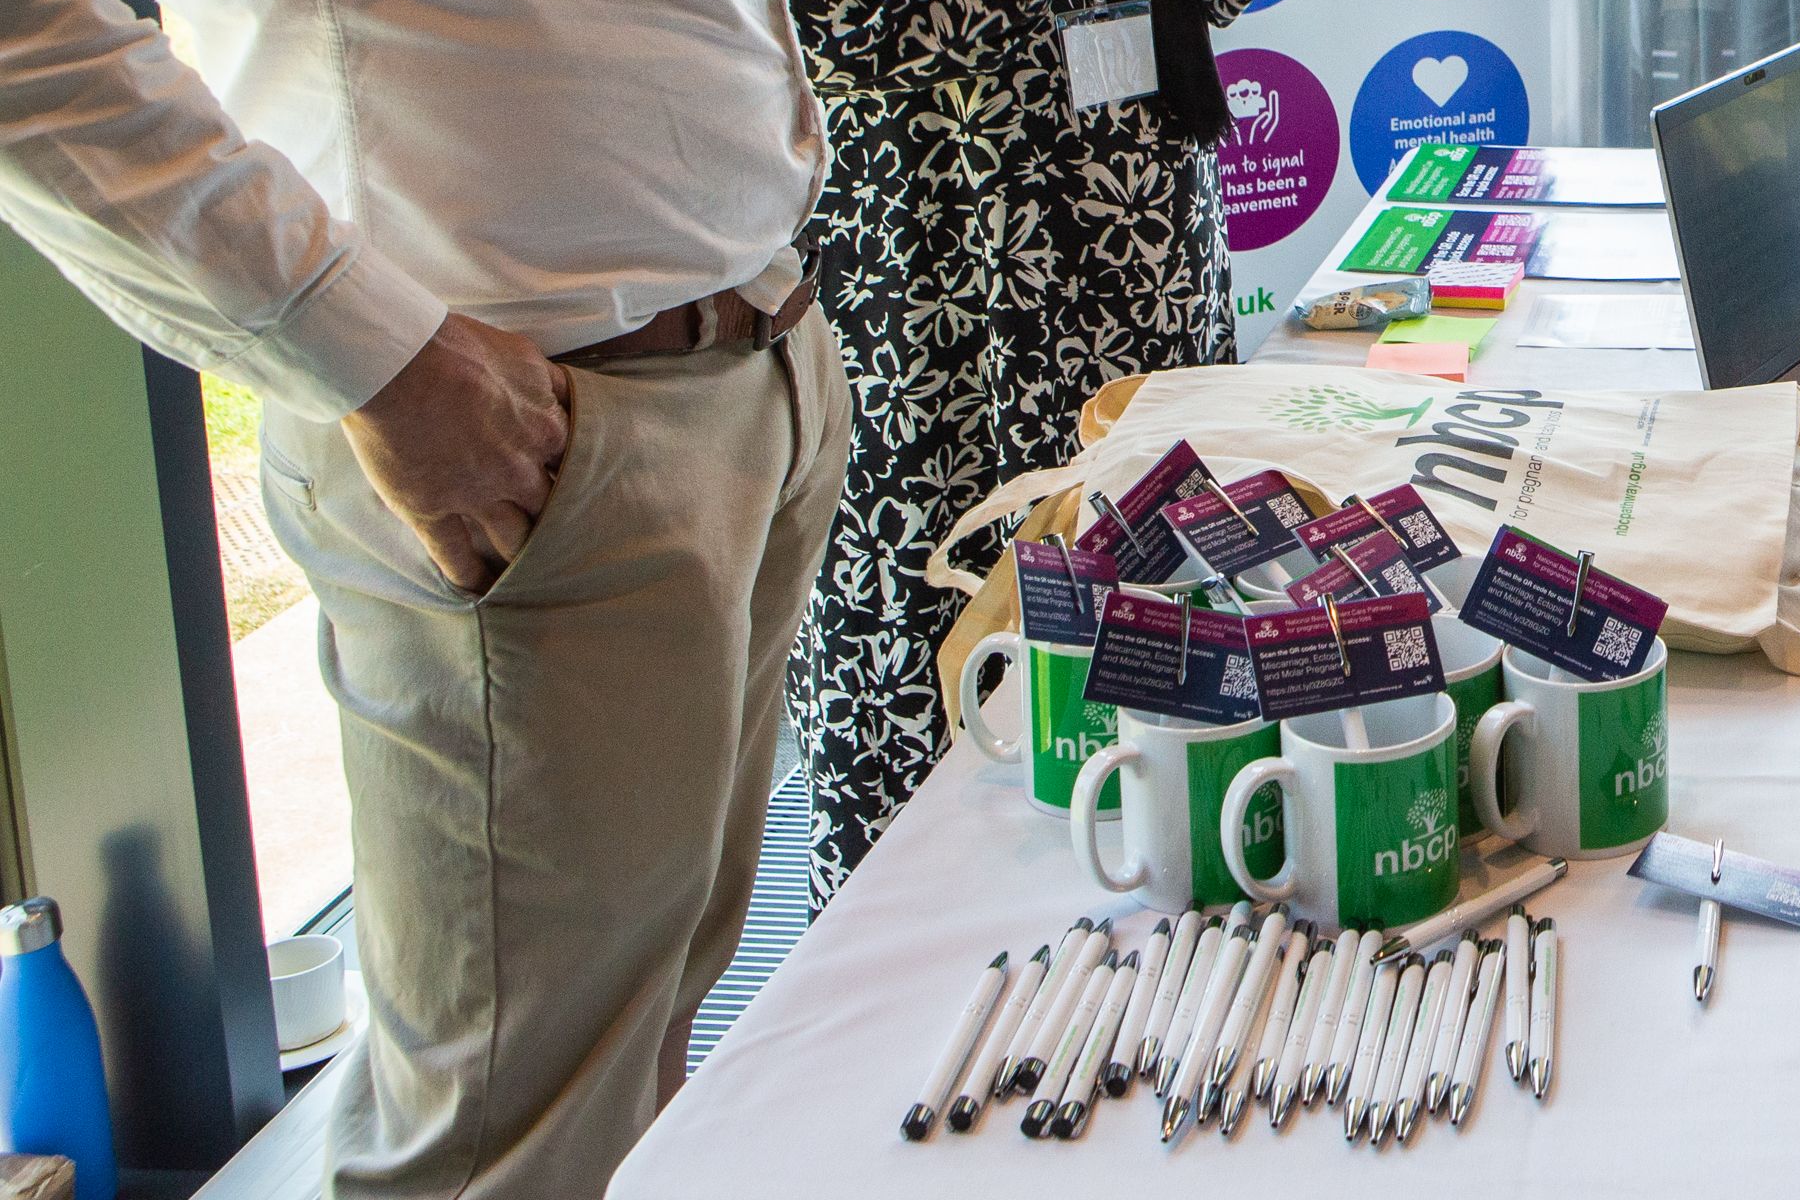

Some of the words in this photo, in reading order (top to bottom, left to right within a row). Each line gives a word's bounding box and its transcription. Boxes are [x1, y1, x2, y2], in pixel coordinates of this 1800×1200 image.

[1390, 113, 1466, 132] Emotional
[1469, 108, 1496, 124] and
[1394, 132, 1446, 149] mental
[1449, 128, 1495, 144] health
[1242, 154, 1257, 173] to
[1262, 149, 1304, 176] signal
[1226, 182, 1253, 197] has
[1257, 177, 1294, 192] been
[1298, 176, 1307, 187] a
[1223, 193, 1298, 215] eavement
[1394, 389, 1564, 512] nbcp
[1615, 450, 1646, 537] nbcpathway.org.uk
[1509, 502, 1528, 521] for
[1504, 547, 1528, 563] nbcp
[1492, 574, 1537, 606] Miscarriage,
[1536, 596, 1565, 616] Ectopic
[1111, 610, 1136, 623] nbcp
[1487, 586, 1502, 599] and
[1502, 591, 1524, 609] Molar
[1524, 601, 1564, 628] Pregnancy
[1254, 628, 1280, 640] nbcp
[1375, 823, 1457, 877] nbcp
